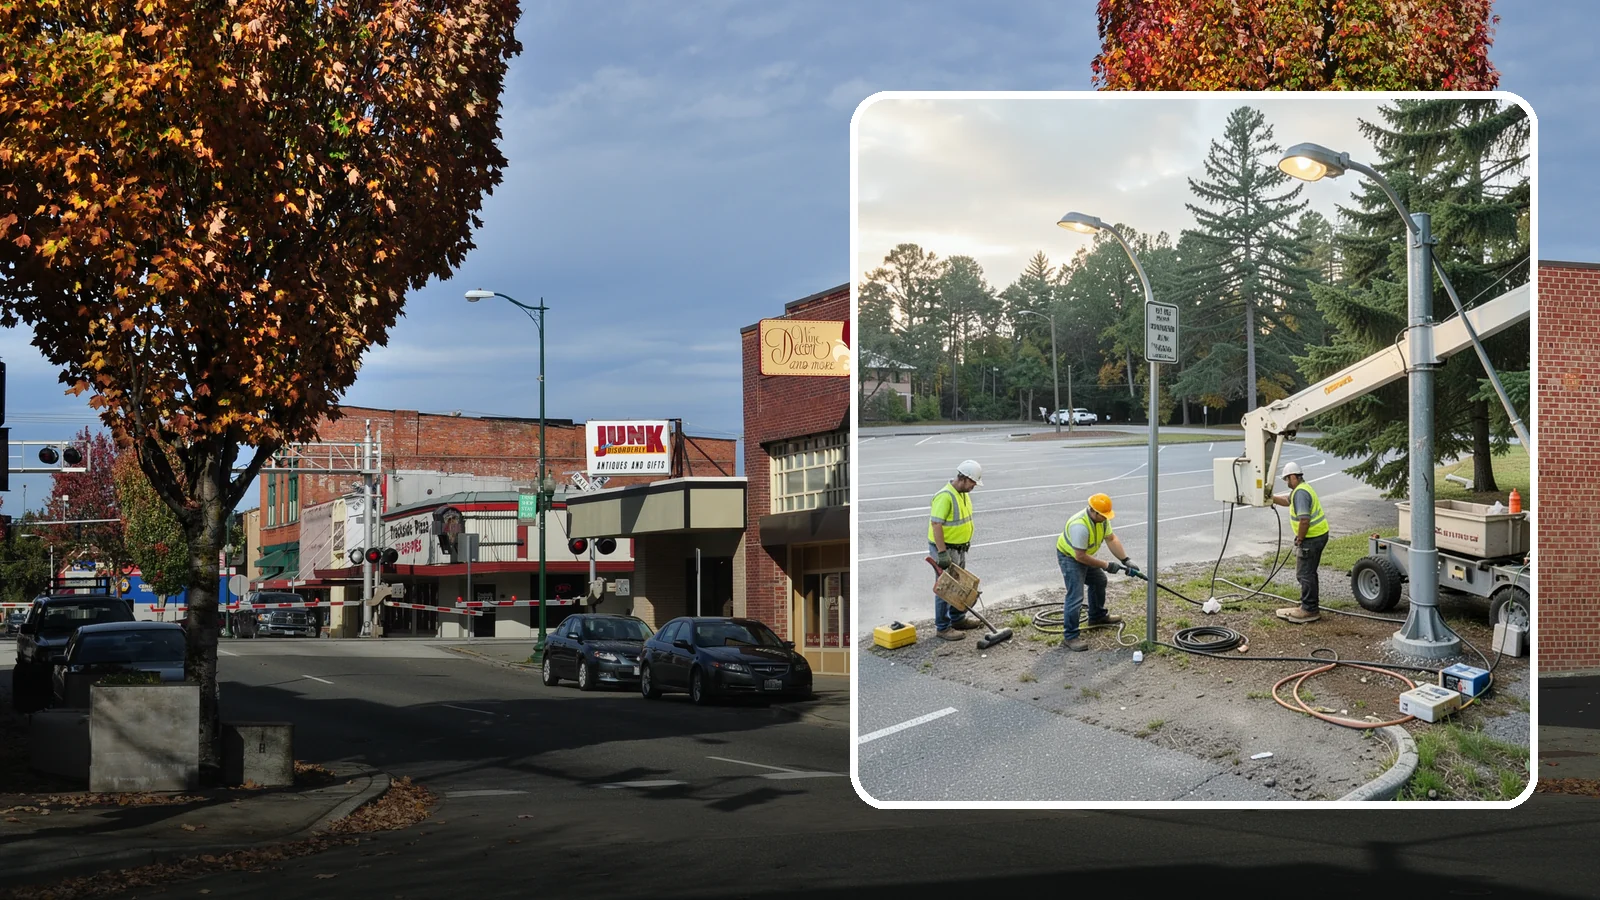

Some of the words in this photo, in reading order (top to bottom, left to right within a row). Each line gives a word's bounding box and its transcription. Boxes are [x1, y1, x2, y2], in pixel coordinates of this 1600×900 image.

[595, 425, 665, 457] JUNK
[607, 446, 646, 454] DISORDERLY
[597, 461, 628, 470] ANTIQUES
[631, 461, 644, 470] AND
[647, 460, 665, 470] GIFTS
[390, 521, 413, 540] Trackside
[414, 519, 429, 535] Pizza
